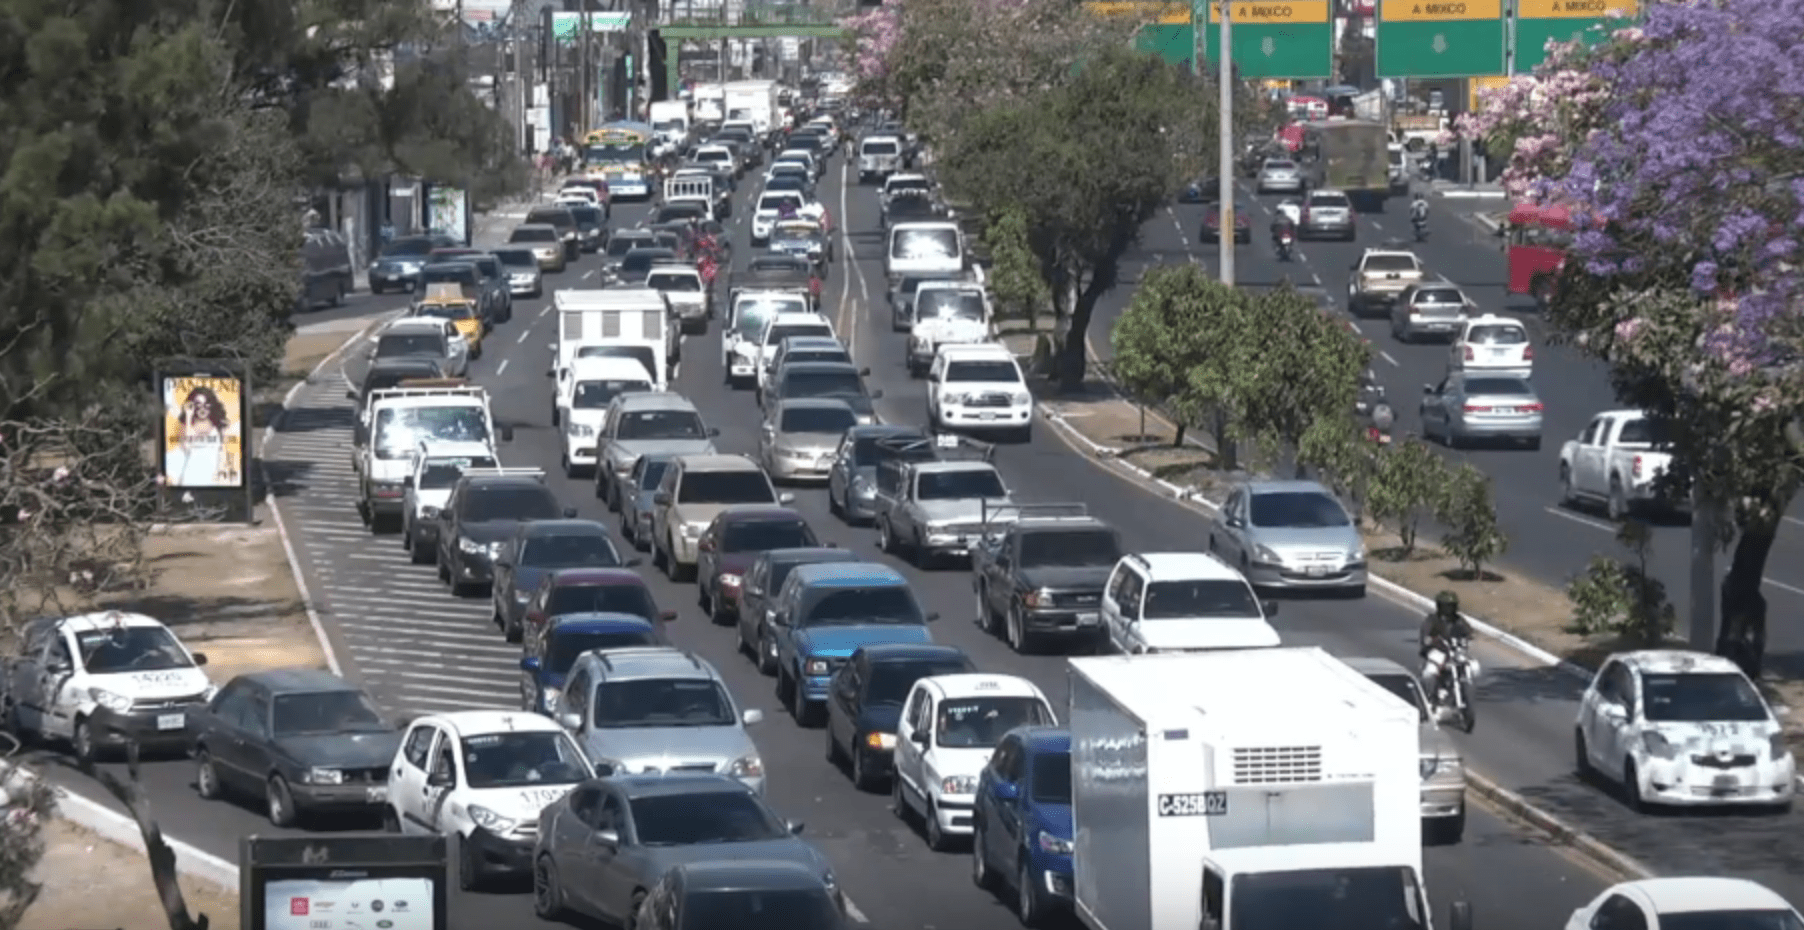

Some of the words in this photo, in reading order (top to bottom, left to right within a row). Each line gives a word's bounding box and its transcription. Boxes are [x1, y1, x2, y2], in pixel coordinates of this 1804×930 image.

[1239, 7, 1247, 17] A
[1252, 6, 1293, 17] MIXCO
[1412, 4, 1421, 14] A
[1425, 3, 1467, 14] MIXCO
[1552, 1, 1561, 12] A
